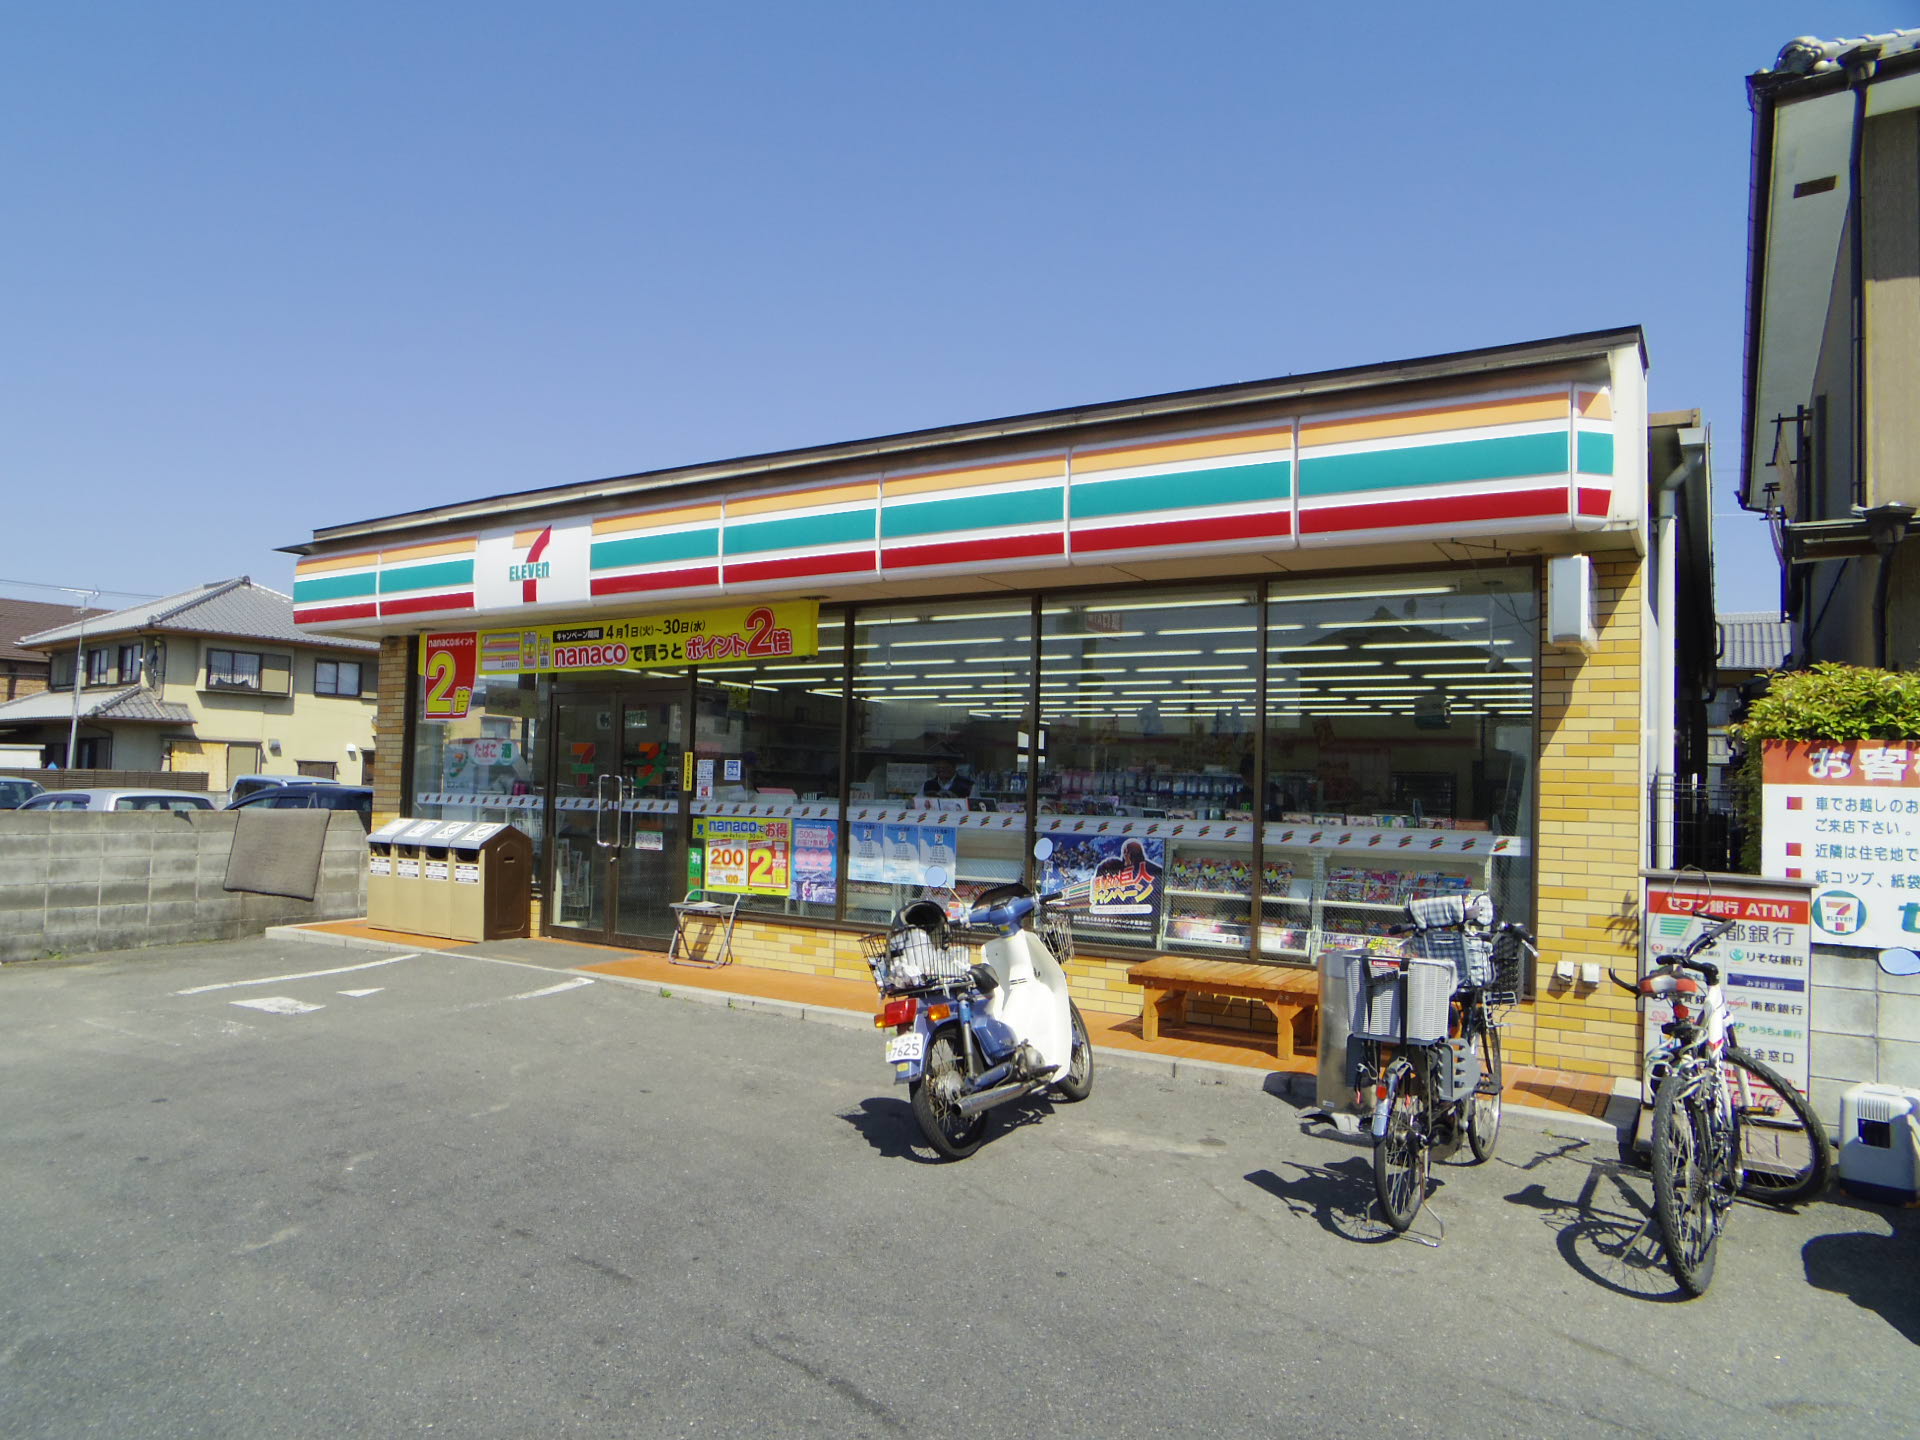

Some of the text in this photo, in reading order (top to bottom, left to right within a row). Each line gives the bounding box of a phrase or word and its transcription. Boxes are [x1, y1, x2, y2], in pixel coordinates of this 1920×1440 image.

[512, 525, 552, 602] 7
[1808, 747, 1920, 781] お客
[1816, 797, 1919, 814] 車でお越しのお
[1816, 819, 1911, 836] ご来店下さい。
[711, 848, 744, 866] 200
[1816, 844, 1920, 862] 近隣は住宅地で
[1667, 896, 1790, 918] セブン銀行 ATM
[1746, 951, 1803, 967] りそな銀行
[1751, 1001, 1803, 1016] 南都銀行
[1749, 1025, 1803, 1039] ゆうちょ銀行
